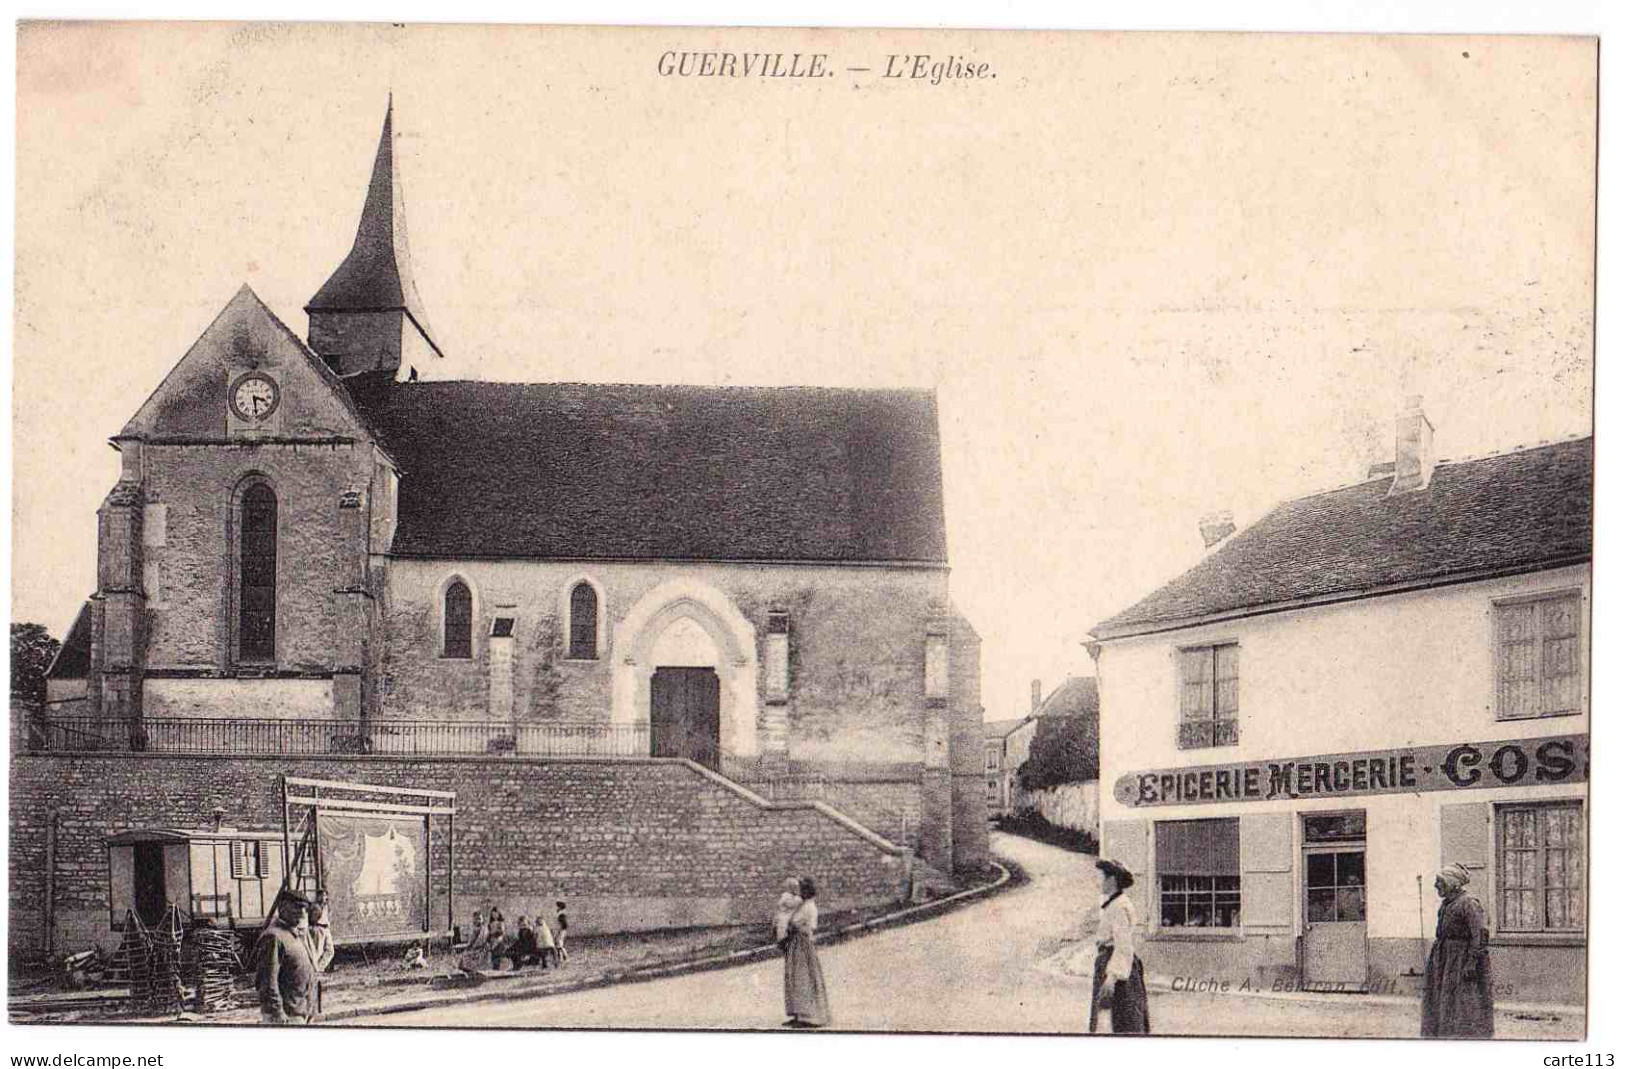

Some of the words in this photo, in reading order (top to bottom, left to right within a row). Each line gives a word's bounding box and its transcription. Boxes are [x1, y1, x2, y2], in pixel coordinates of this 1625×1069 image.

[1134, 767, 1260, 806] EPICERIE
[1266, 755, 1416, 799] MERCERIE
[1440, 741, 1589, 787] COS
